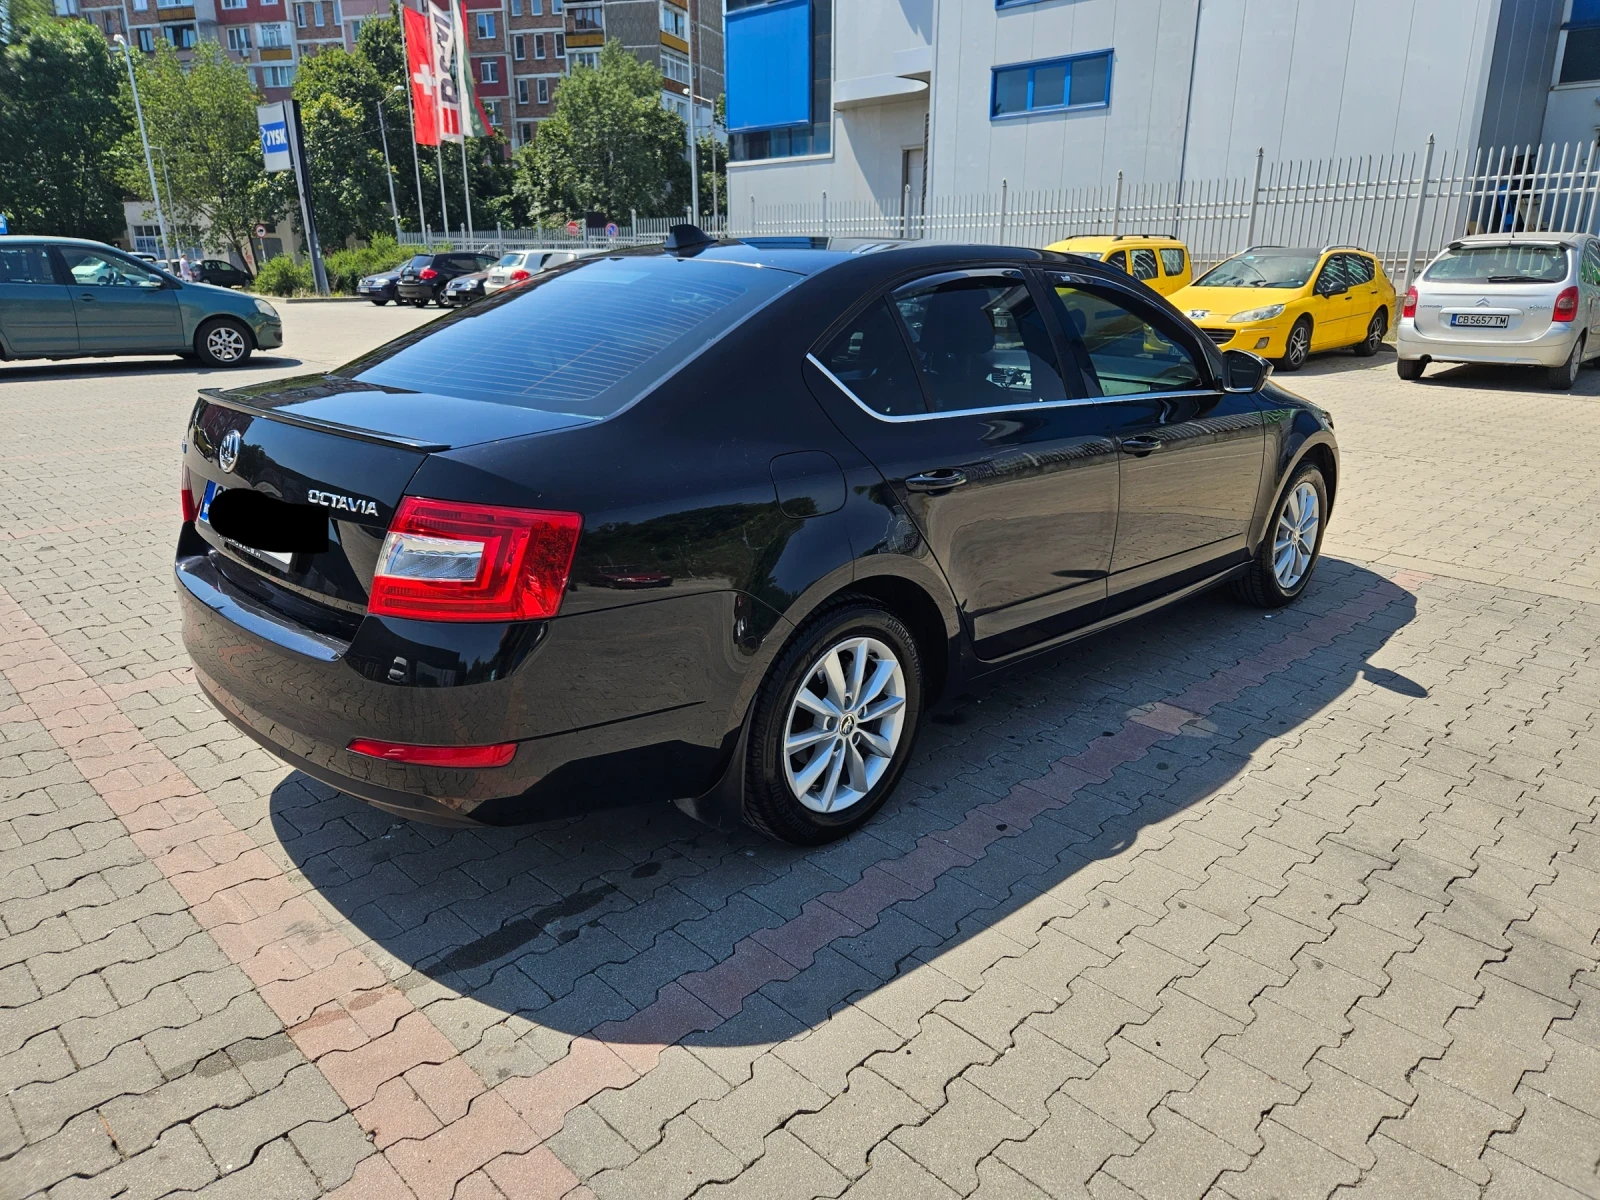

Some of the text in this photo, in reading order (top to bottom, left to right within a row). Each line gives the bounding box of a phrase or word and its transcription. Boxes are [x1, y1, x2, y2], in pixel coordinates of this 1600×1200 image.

[266, 128, 287, 147] JYSK
[1457, 315, 1507, 325] CB 5657 TM
[307, 489, 379, 517] OCTAVIA
